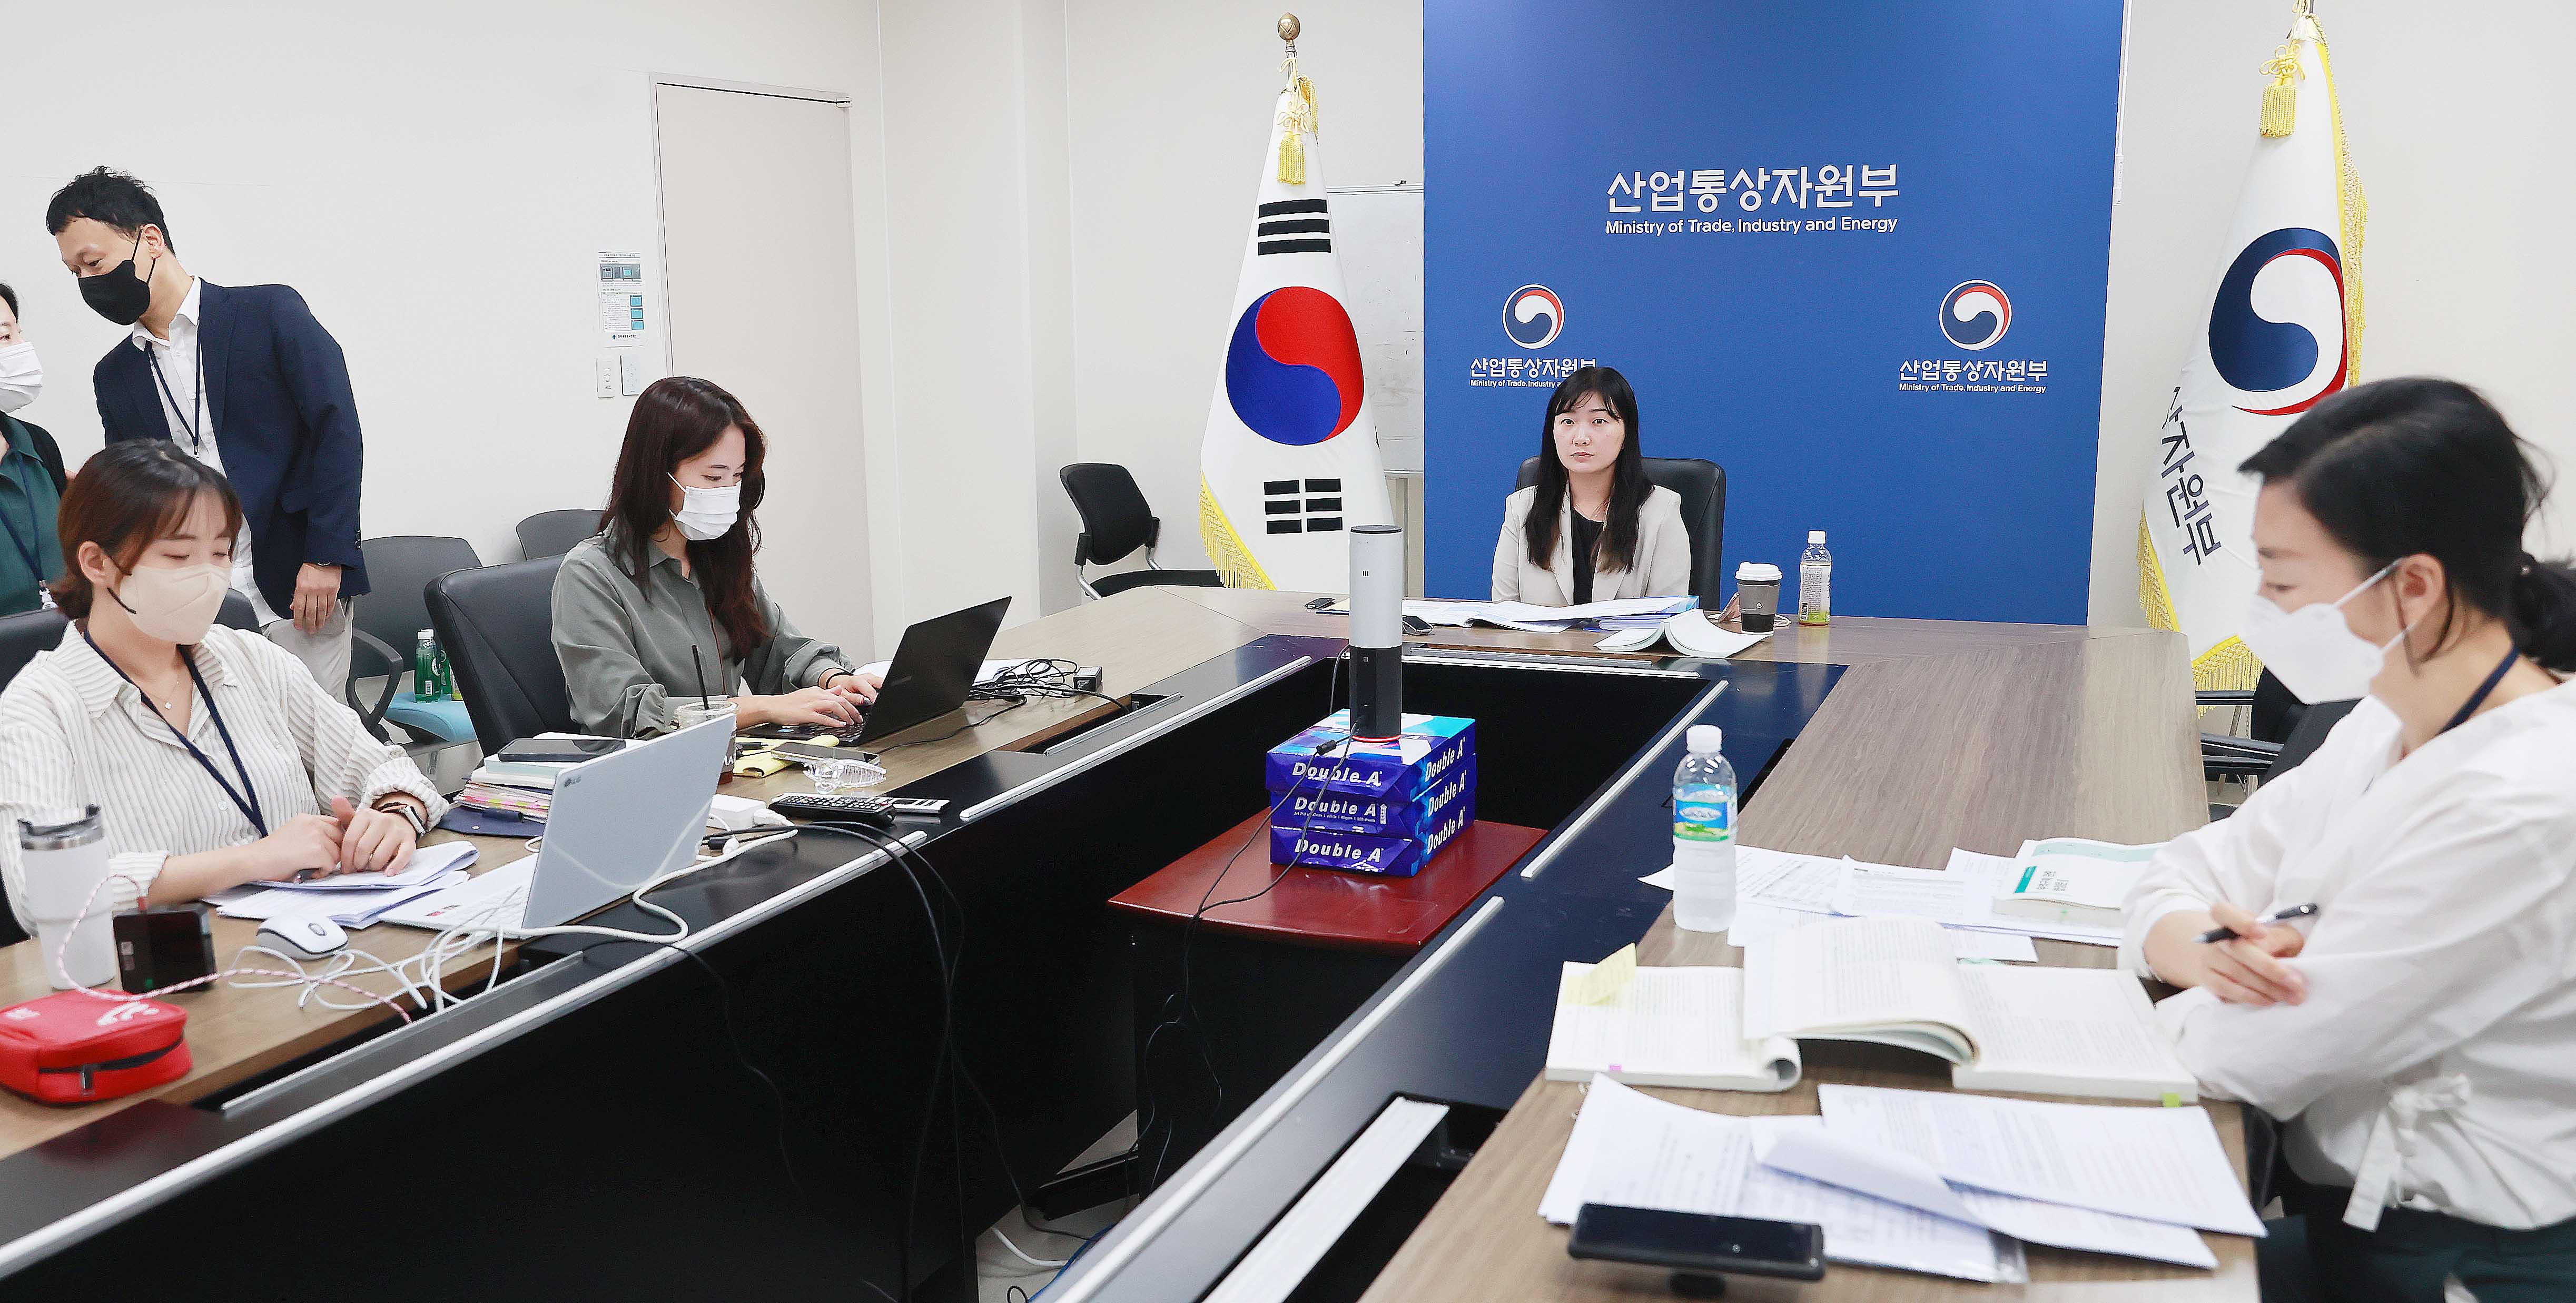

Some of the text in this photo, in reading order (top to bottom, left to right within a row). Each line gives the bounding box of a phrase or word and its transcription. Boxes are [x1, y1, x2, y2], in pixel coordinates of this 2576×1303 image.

[1606, 164, 1900, 213] 산업통상자원부
[1606, 216, 1898, 236] Ministry of Trade, Industry and Energy
[1899, 360, 2048, 382] 산업통상자원부
[1470, 380, 1497, 388] Ministry
[1899, 383, 1930, 392] Ministry
[1967, 383, 1999, 393] Industry
[2018, 384, 2047, 393] Energy
[1425, 739, 1463, 782] Double A
[1292, 762, 1381, 786] Double A
[1428, 772, 1465, 817] Double A
[1294, 797, 1358, 815] Double
[1364, 803, 1376, 817] A
[1427, 809, 1464, 855] Double A
[1294, 839, 1381, 862] Double A
